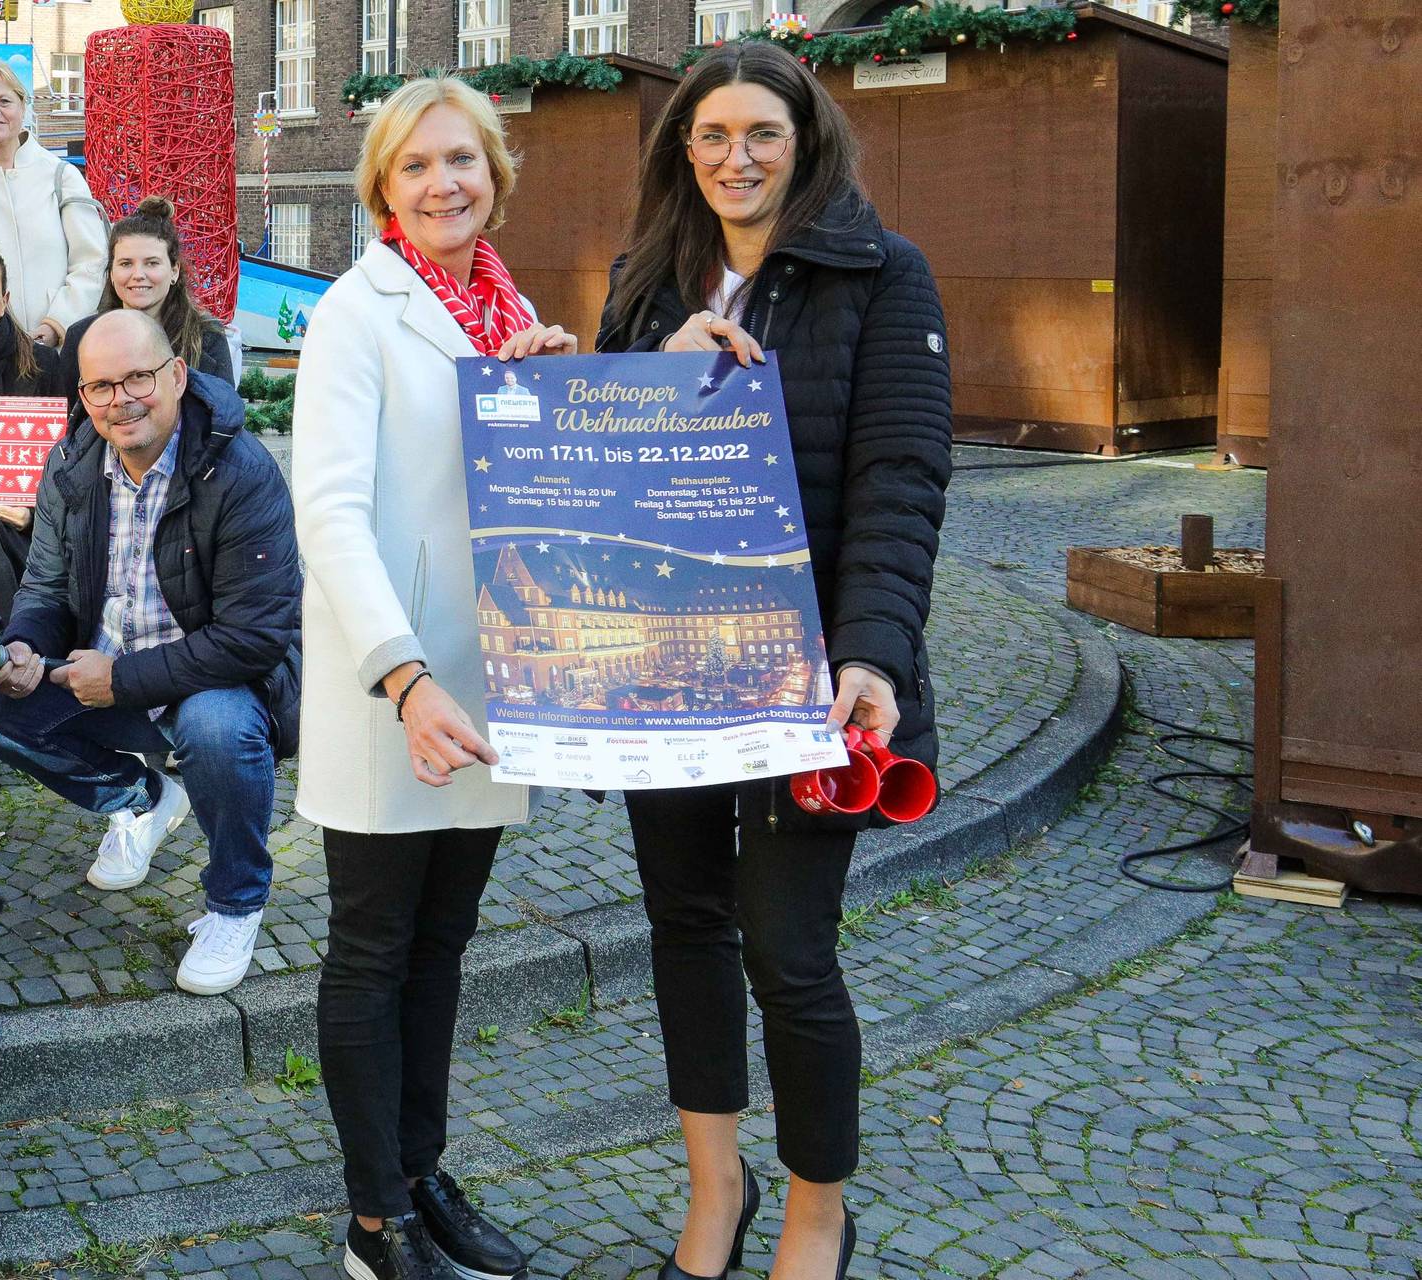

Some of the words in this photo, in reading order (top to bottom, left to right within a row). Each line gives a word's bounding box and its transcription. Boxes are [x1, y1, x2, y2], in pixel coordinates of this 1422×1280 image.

[565, 378, 679, 410] Bottroper
[553, 406, 772, 433] Weihnachtszauber
[503, 446, 544, 460] vom
[549, 444, 599, 462] 17.11.
[604, 447, 633, 462] bis
[638, 443, 751, 463] 22.12.2022
[533, 475, 571, 485] Altmarkt
[671, 476, 731, 486] Rathausplatz
[489, 484, 562, 497] Montag-Samstag:
[563, 488, 572, 496] 11
[574, 488, 587, 496] bis
[588, 488, 599, 497] 20
[601, 488, 617, 497] Uhr
[647, 488, 700, 498] Donnerstag:
[701, 488, 712, 496] 15
[713, 487, 727, 495] bis
[728, 486, 739, 494] 21
[742, 485, 759, 494] Uhr
[507, 496, 545, 507] Sonntag:
[558, 499, 571, 507] bis
[572, 499, 583, 507] 20
[585, 500, 600, 508] Uhr
[634, 500, 664, 510] Freitag
[665, 500, 673, 508] &
[674, 499, 715, 509] Samstag:
[717, 498, 727, 506] 15
[729, 498, 743, 506] bis
[744, 497, 756, 505] 22
[758, 495, 775, 504] Uhr
[656, 511, 696, 521] Sonntag:
[697, 510, 708, 518] 15
[710, 510, 723, 518] bis
[724, 509, 736, 517] 20
[738, 508, 755, 517] Uhr
[495, 707, 535, 720] Weitere
[538, 711, 608, 725] Informationen
[611, 715, 643, 726] unter:
[644, 710, 827, 726] www.weihnachtsmarkt-bottrop.de
